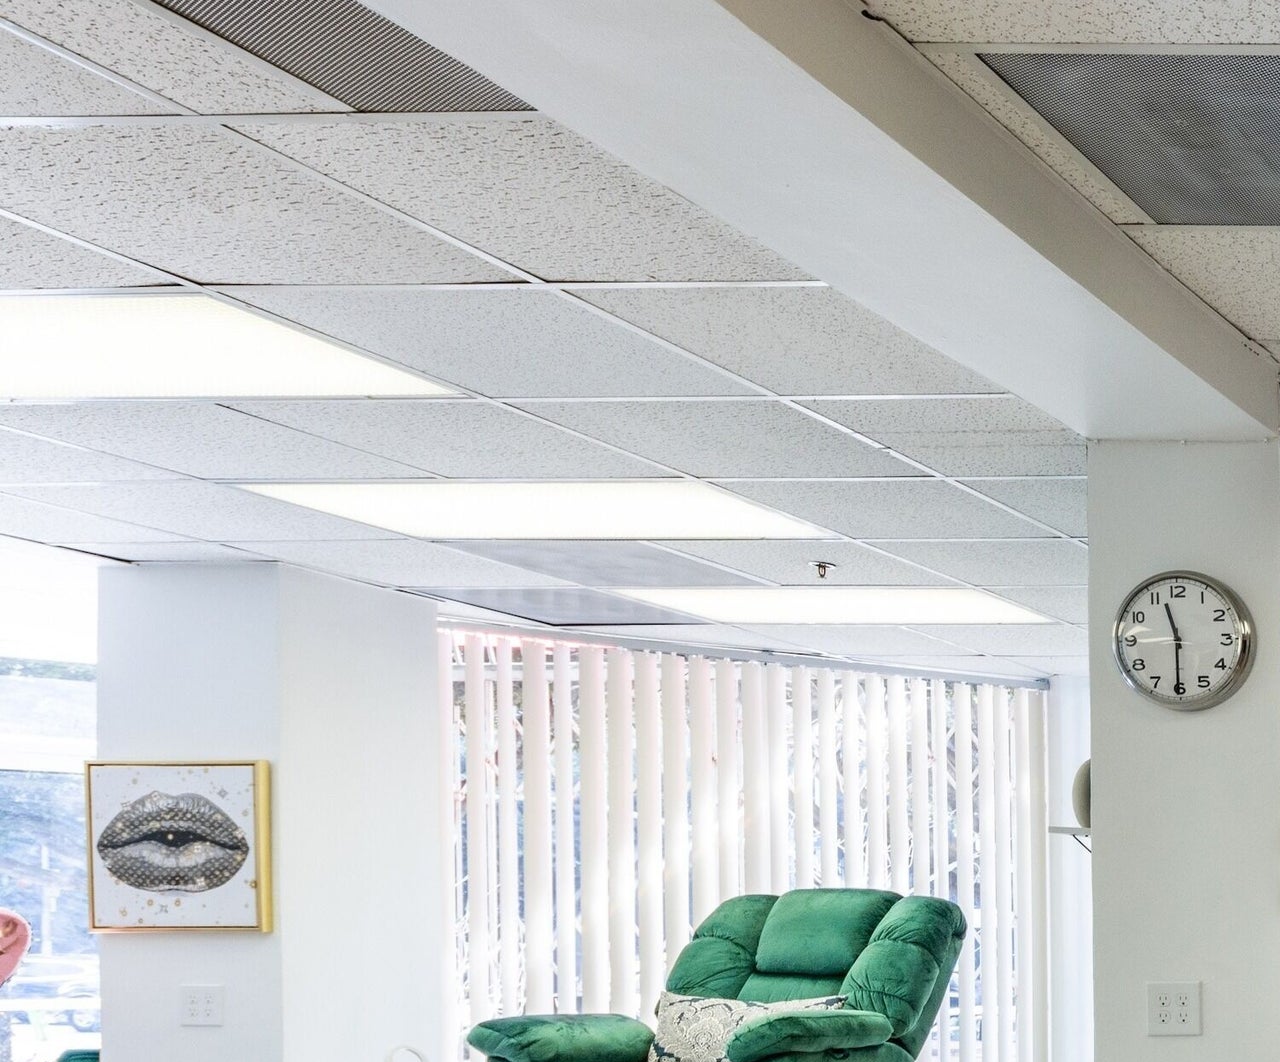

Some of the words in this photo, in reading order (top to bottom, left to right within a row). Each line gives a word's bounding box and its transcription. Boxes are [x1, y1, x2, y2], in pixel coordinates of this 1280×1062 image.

[1150, 592, 1160, 605] 11
[1170, 585, 1186, 599] 12
[1132, 611, 1145, 624] 10
[1213, 609, 1226, 622] 2
[1124, 635, 1137, 647] 9
[1220, 633, 1233, 646] 3
[1132, 658, 1146, 671] 8
[1214, 658, 1227, 671] 4
[1149, 676, 1161, 689] 7
[1197, 675, 1210, 688] 5
[1173, 682, 1186, 695] 6
